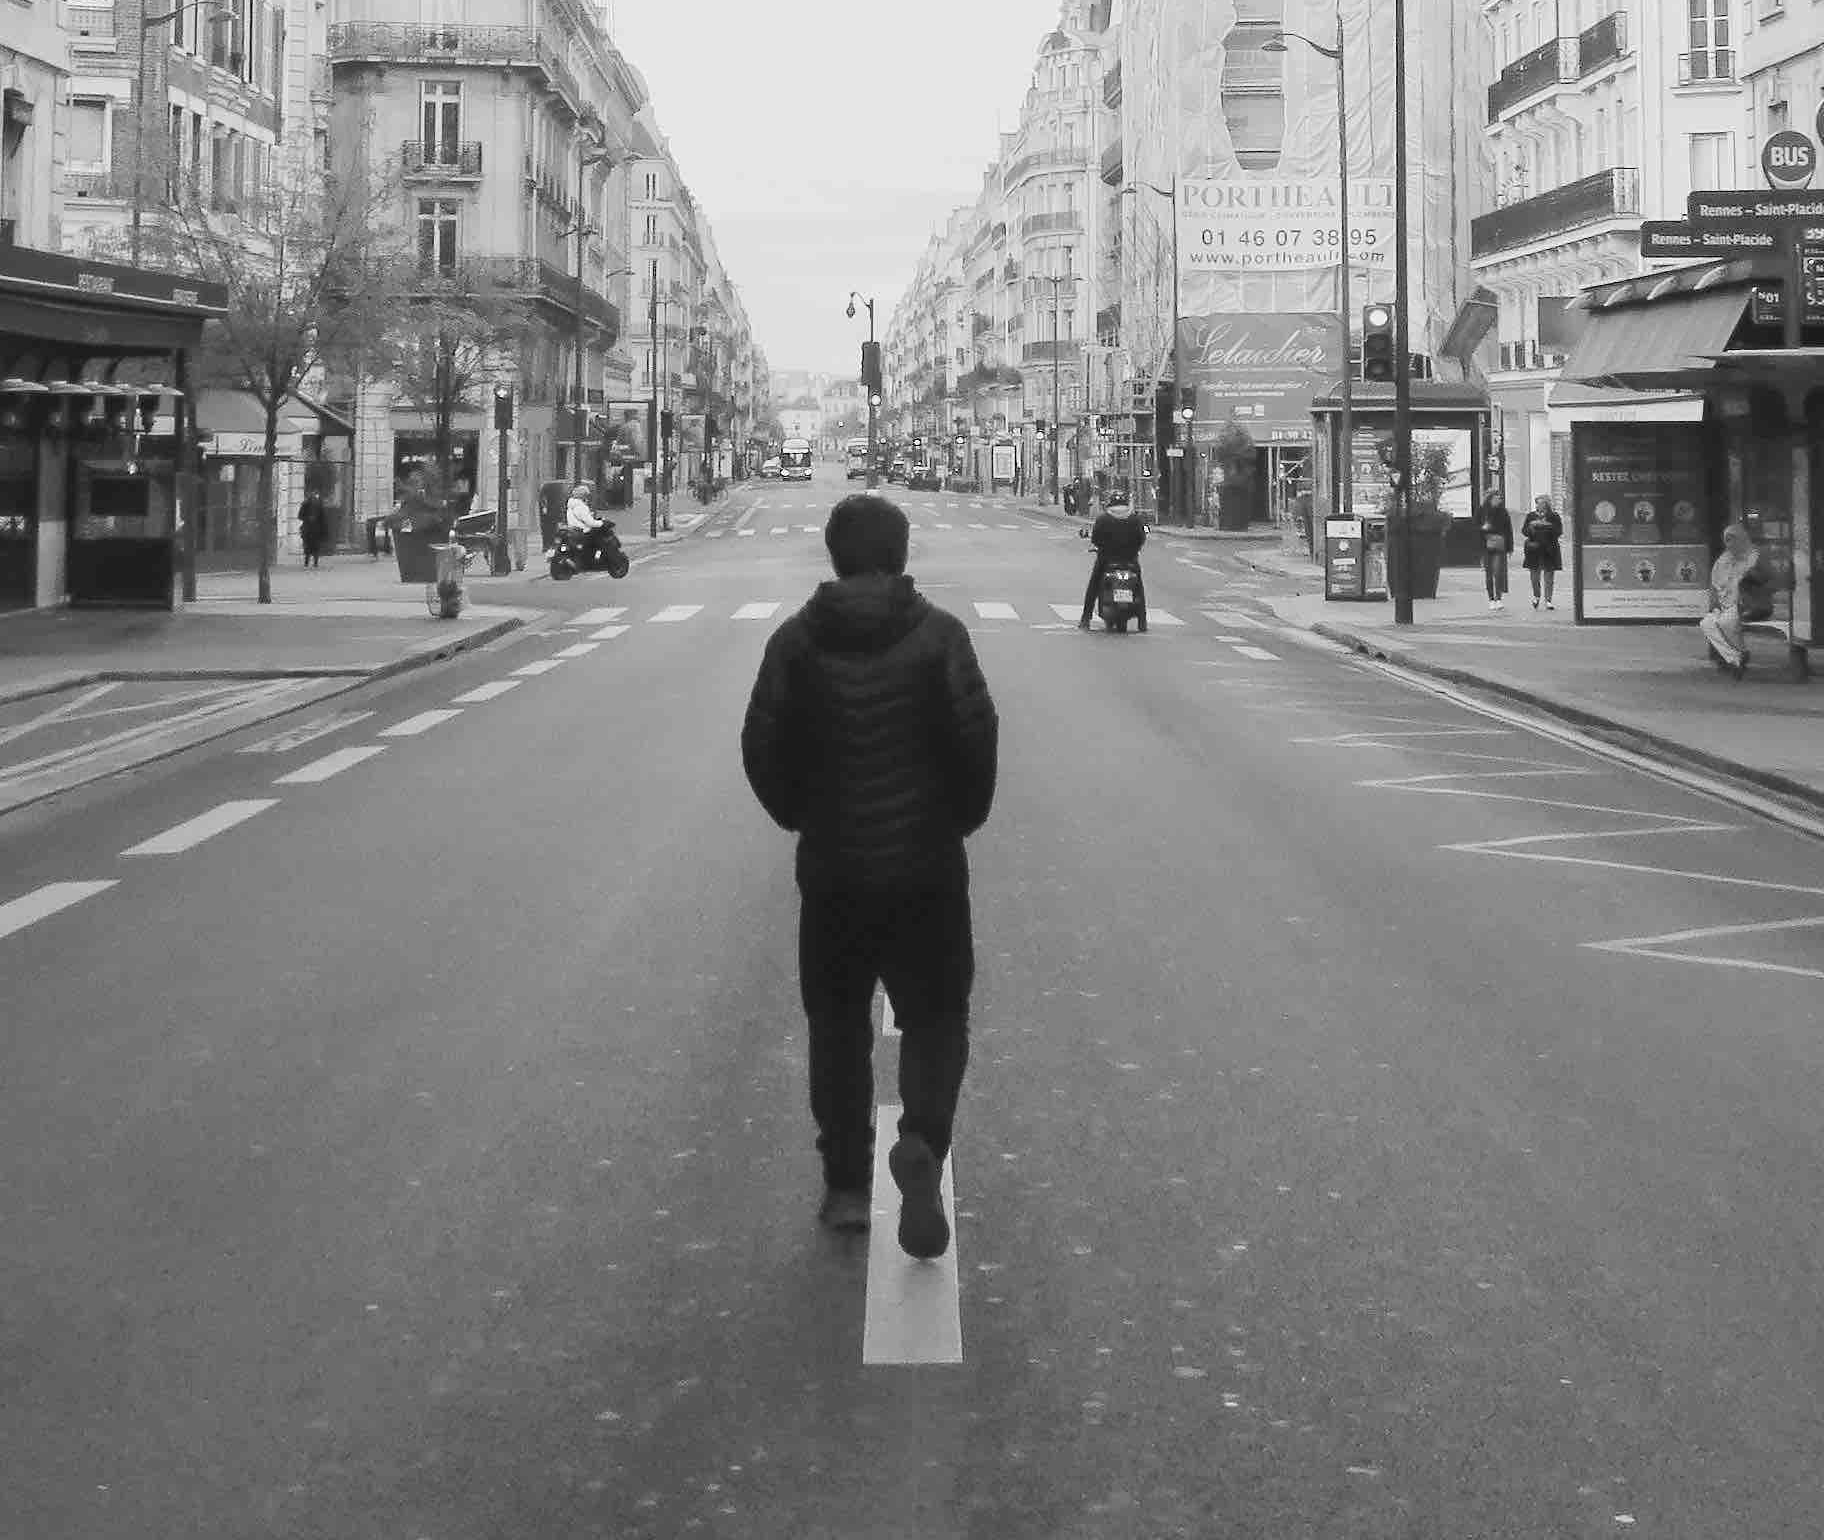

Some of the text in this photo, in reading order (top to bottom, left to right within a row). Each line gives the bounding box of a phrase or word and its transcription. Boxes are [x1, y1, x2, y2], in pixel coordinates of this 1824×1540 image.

[1770, 147, 1809, 166] BUS
[1700, 204, 1744, 217] Rennes
[1201, 228, 1377, 247] 01 46 07 38 95
[1651, 233, 1692, 246] Rennes
[1703, 232, 1774, 247] Saint-Placide
